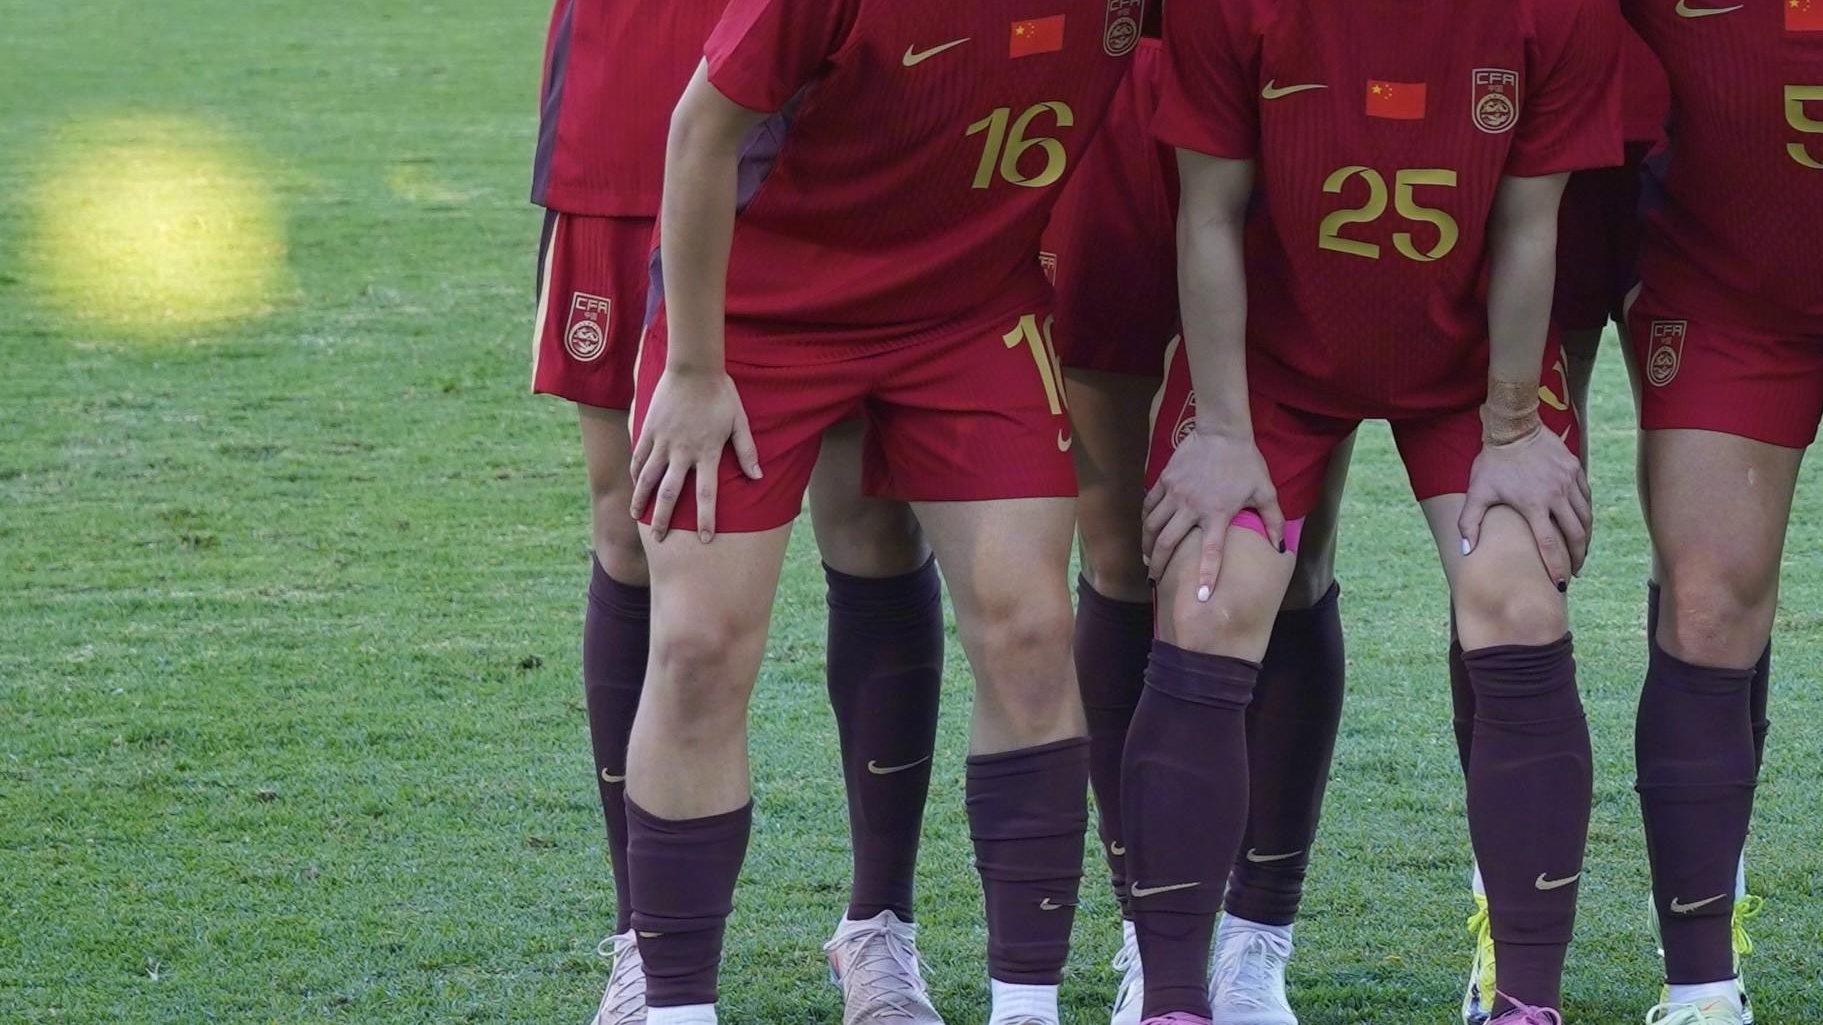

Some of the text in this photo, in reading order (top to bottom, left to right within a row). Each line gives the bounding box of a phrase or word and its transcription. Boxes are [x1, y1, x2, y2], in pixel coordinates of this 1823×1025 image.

[1477, 73, 1516, 87] CFA
[965, 100, 1075, 190] 16
[1319, 165, 1459, 262] 25
[576, 296, 609, 315] CFA
[1654, 325, 1682, 336] CFA
